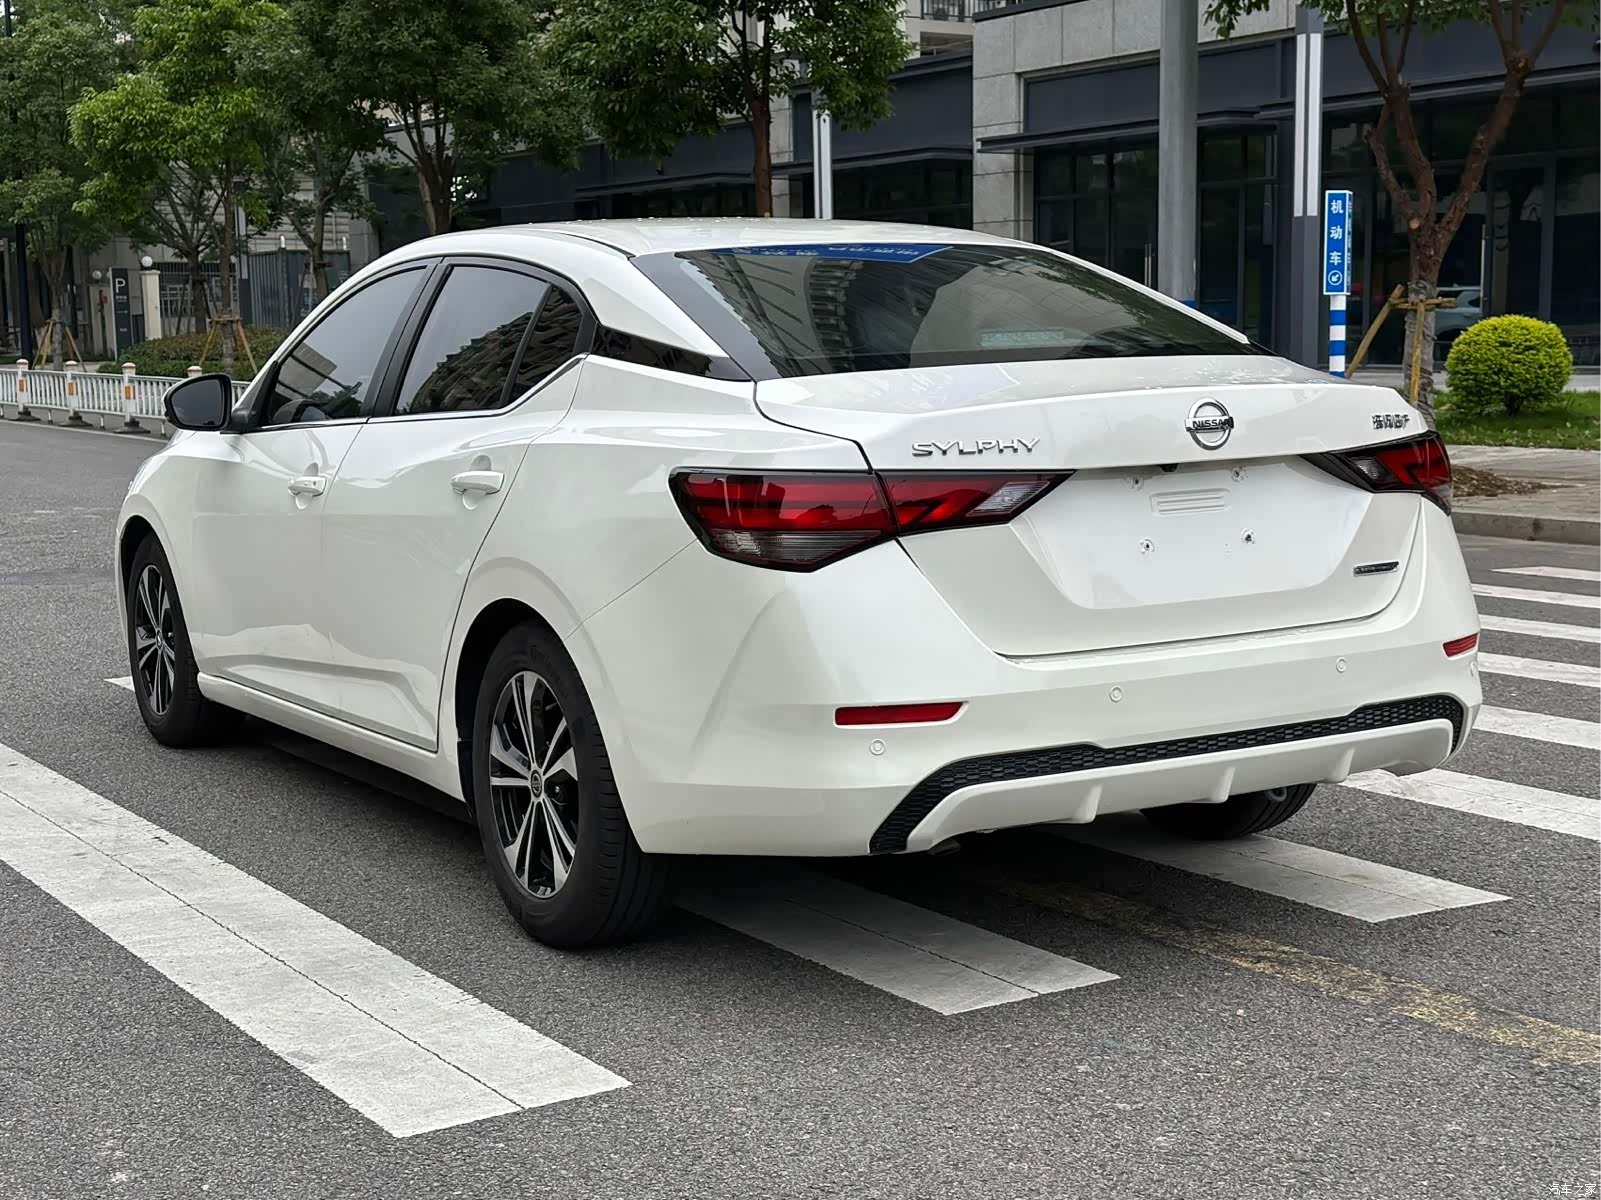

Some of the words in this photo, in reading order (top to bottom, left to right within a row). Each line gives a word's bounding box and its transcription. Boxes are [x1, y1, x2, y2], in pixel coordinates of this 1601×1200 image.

[1329, 199, 1344, 266] 机动车
[115, 278, 126, 294] P
[911, 437, 1041, 457] SYLPHY
